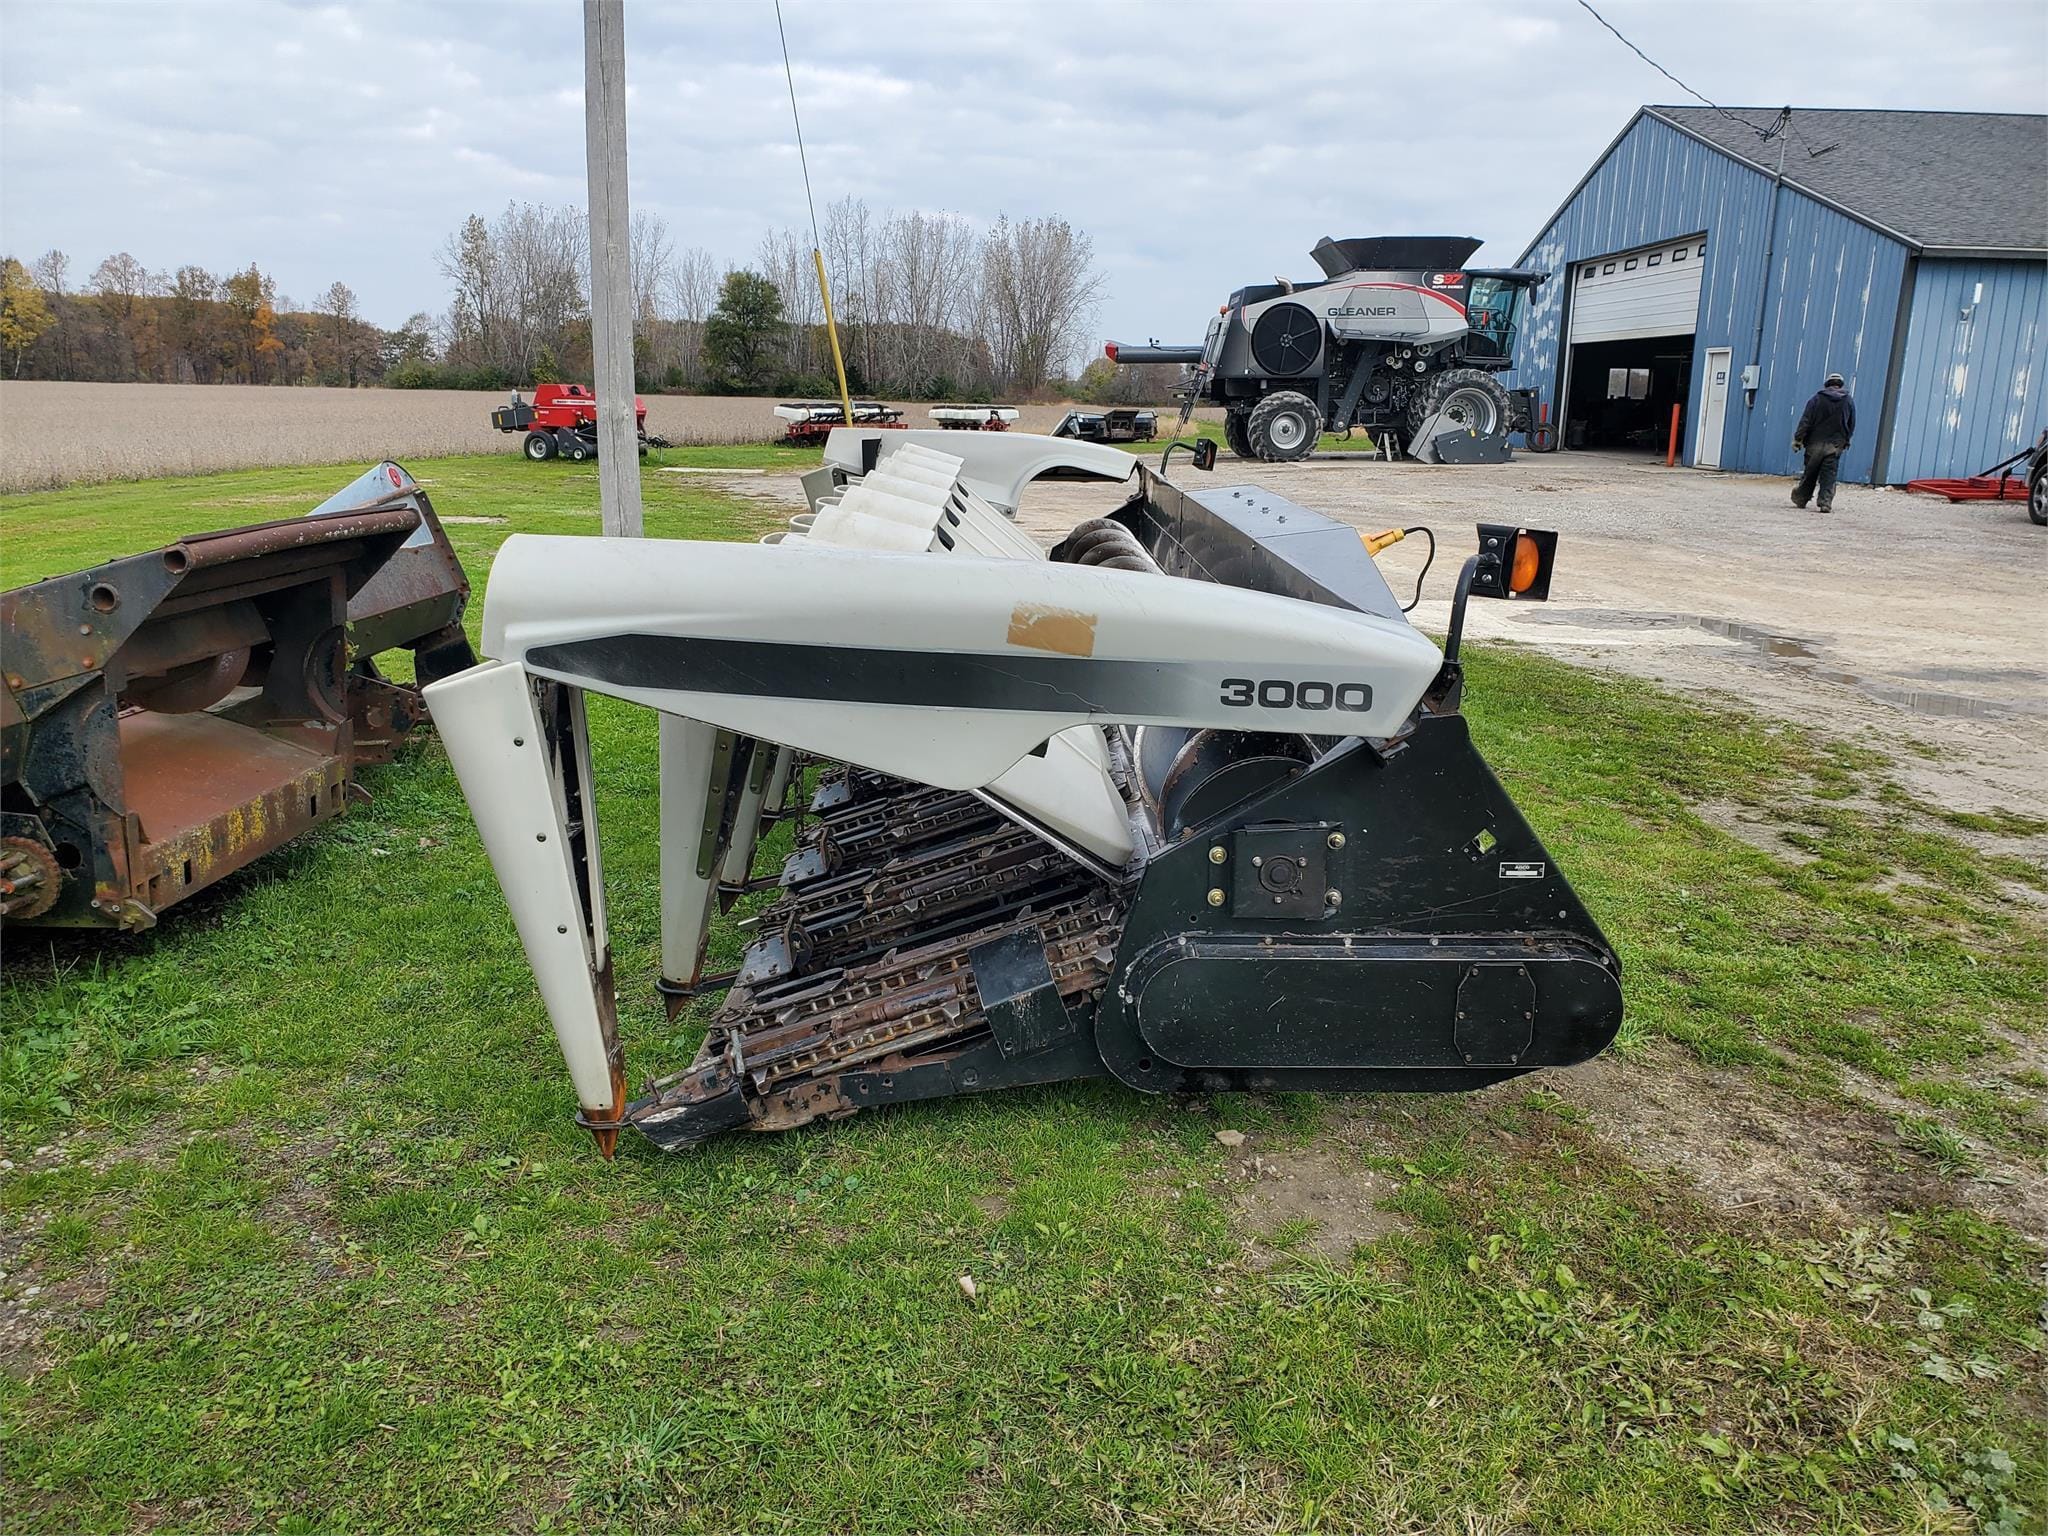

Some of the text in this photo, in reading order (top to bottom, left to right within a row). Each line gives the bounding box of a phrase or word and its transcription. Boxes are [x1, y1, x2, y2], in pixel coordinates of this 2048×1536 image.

[1432, 274, 1464, 284] S97
[1327, 307, 1396, 317] GLEANER
[1220, 678, 1373, 713] 3000
